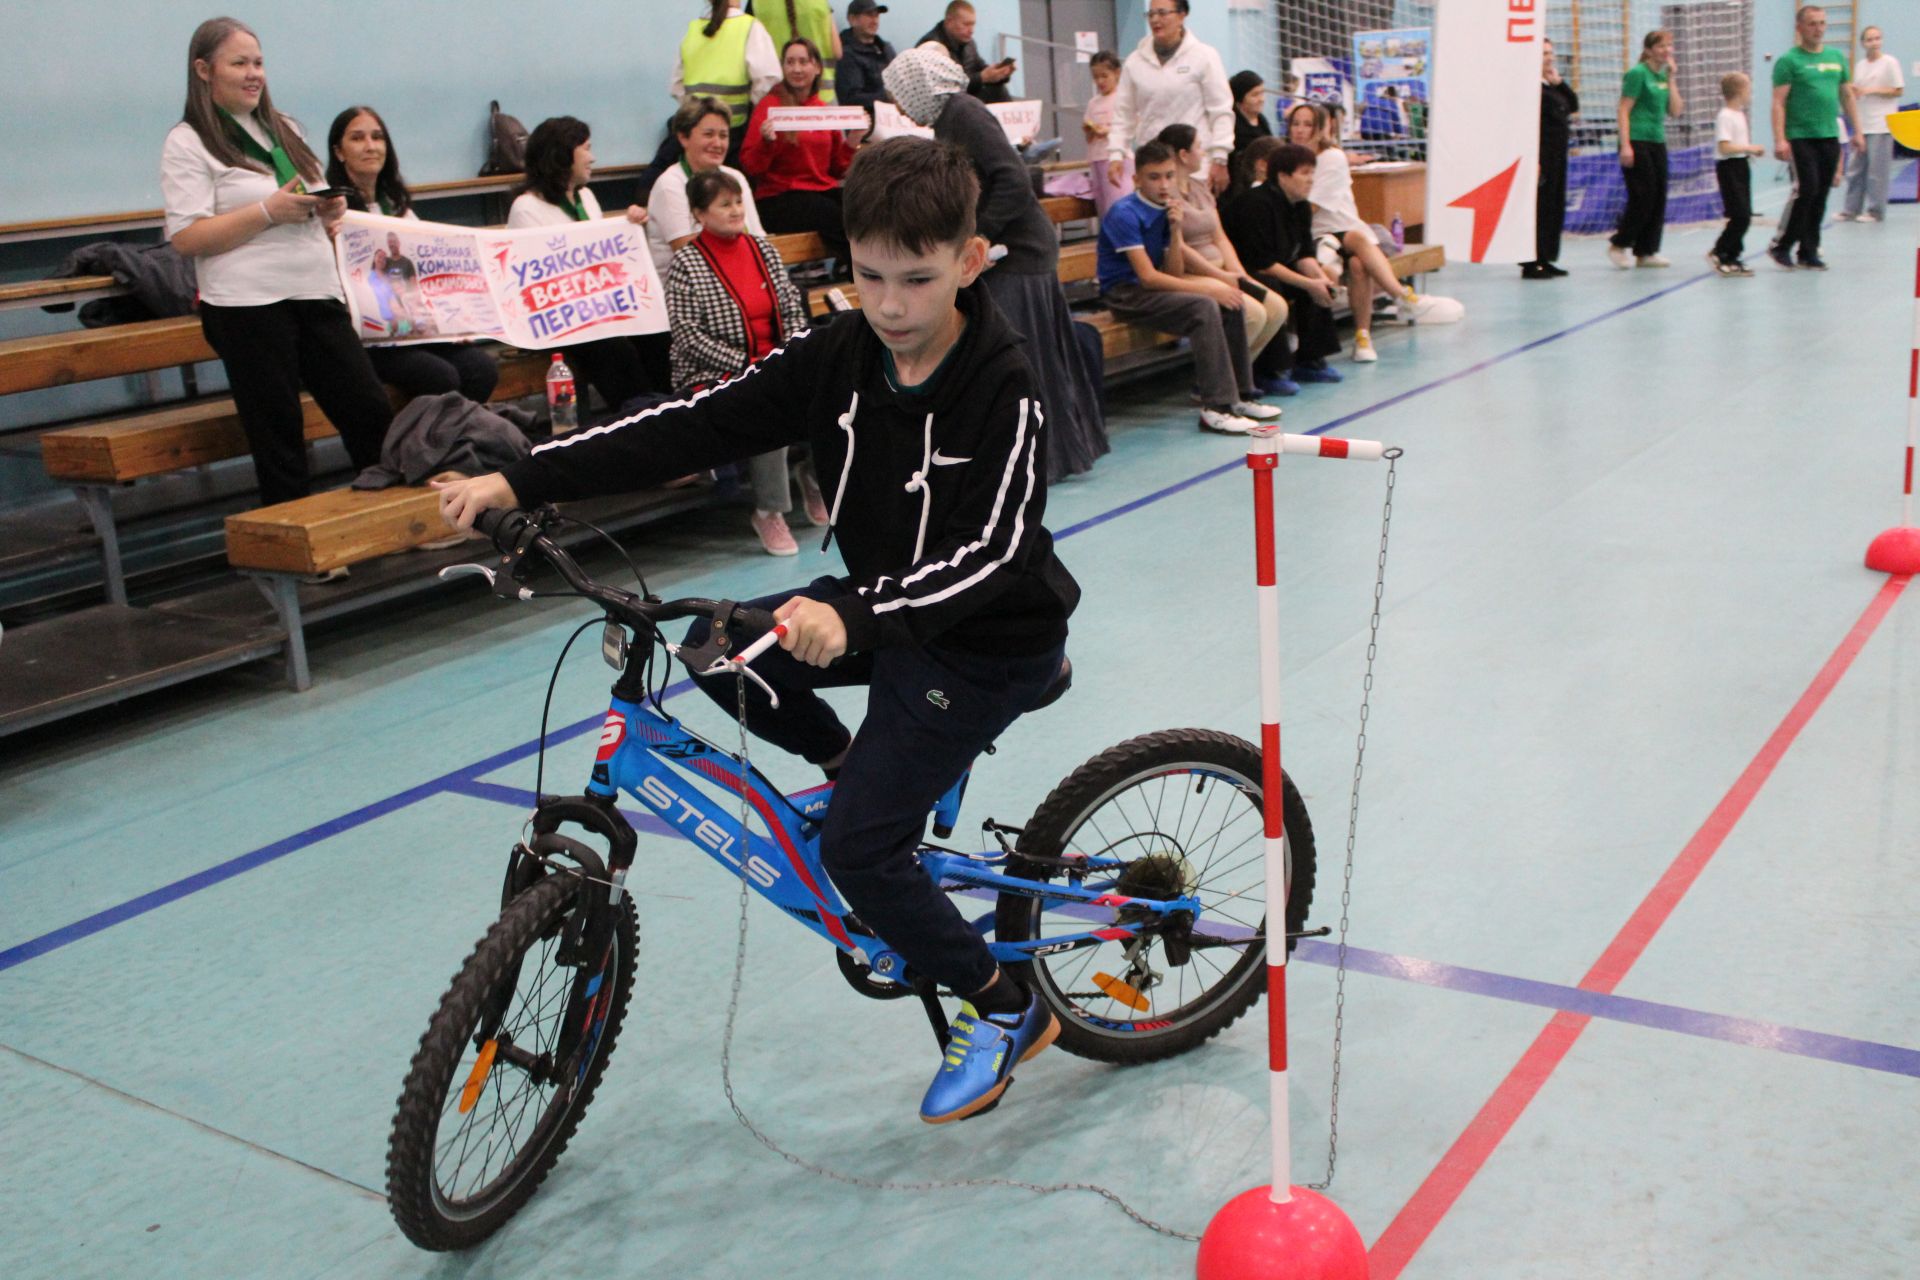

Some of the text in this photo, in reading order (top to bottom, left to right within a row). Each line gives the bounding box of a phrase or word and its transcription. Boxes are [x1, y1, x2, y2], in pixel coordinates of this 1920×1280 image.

[416, 258, 483, 276] КОМАНДА
[511, 233, 629, 287] УЗЯКСКИЕ
[530, 264, 618, 310] ВСЕГДА
[528, 284, 639, 339] ПЕРВЫЕ!
[635, 775, 782, 888] STELS
